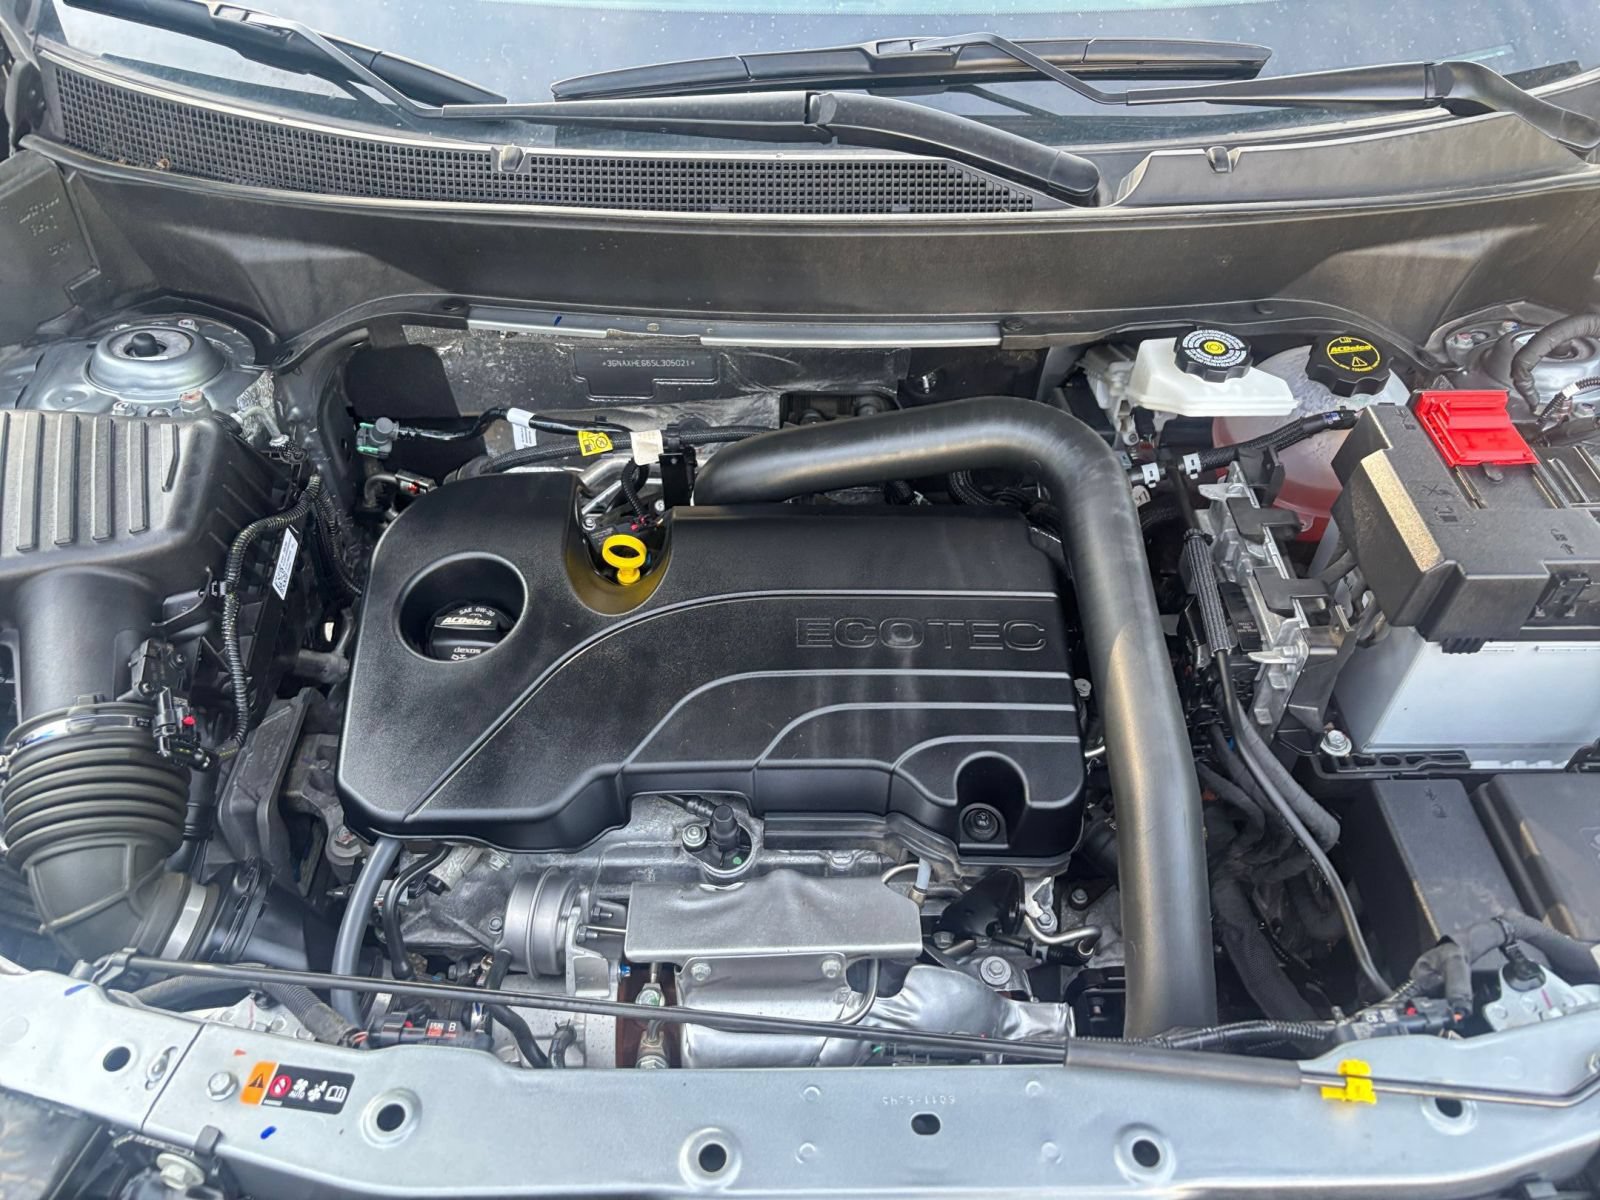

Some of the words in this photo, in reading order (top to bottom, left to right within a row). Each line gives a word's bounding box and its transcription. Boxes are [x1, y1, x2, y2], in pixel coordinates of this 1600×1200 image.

[1330, 344, 1372, 354] ACDelco
[440, 617, 492, 626] ACDelco
[796, 617, 1047, 651] ECOTEC
